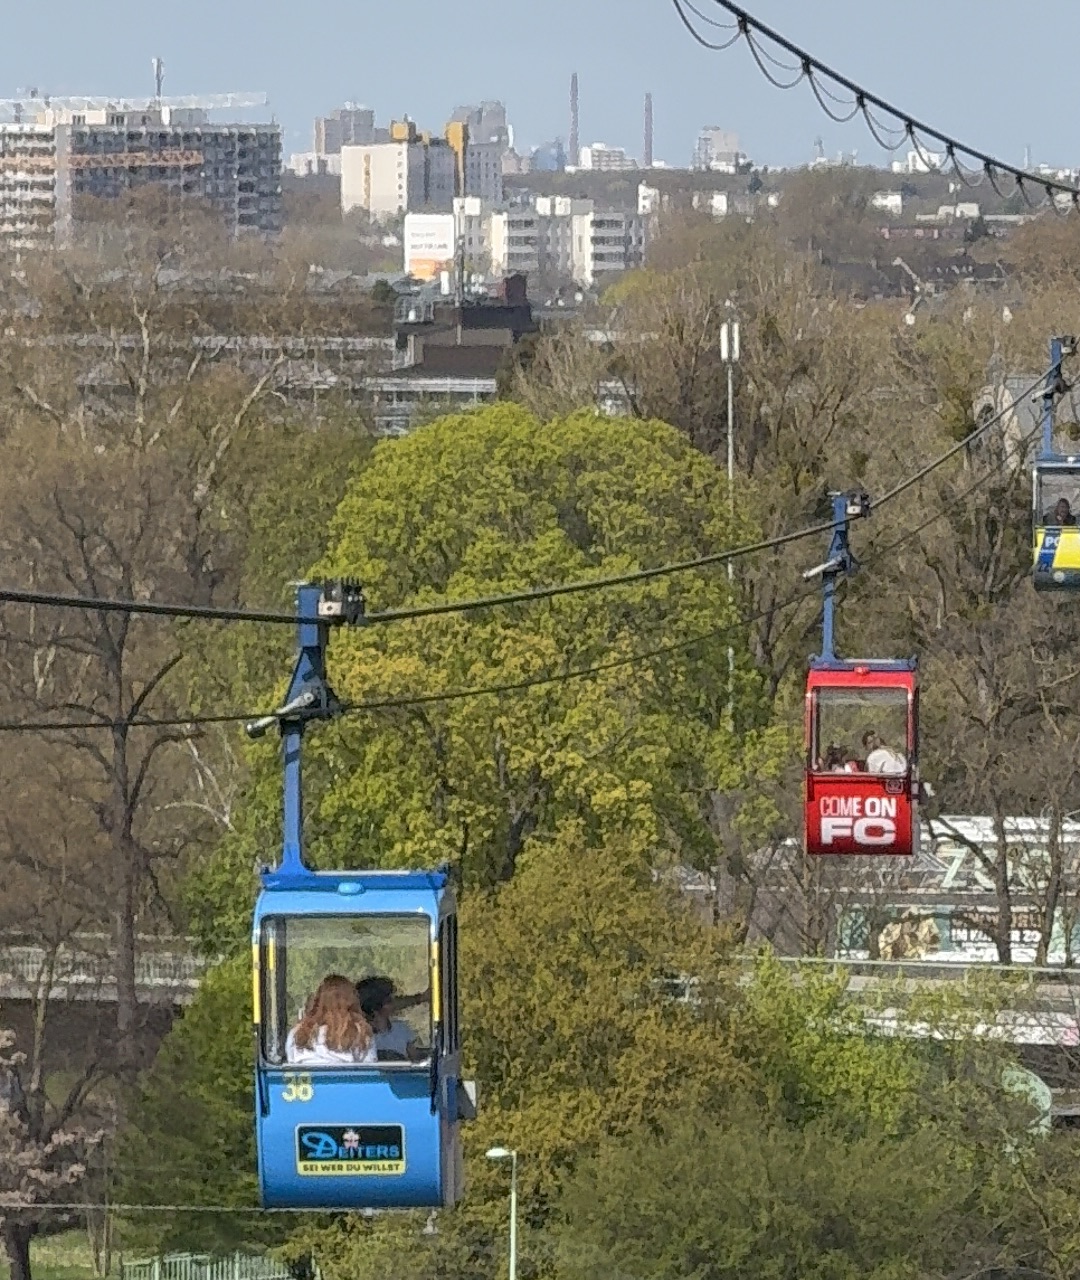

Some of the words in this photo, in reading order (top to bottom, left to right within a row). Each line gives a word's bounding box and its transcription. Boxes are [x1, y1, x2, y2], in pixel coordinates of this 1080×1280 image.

[820, 796, 862, 817] COME
[864, 796, 897, 818] ON
[820, 817, 897, 845] FC
[301, 1131, 400, 1159] DEITERS
[302, 1163, 319, 1172] SEI
[320, 1163, 344, 1172] WER
[346, 1163, 361, 1172] DU
[362, 1163, 401, 1172] WILLST
